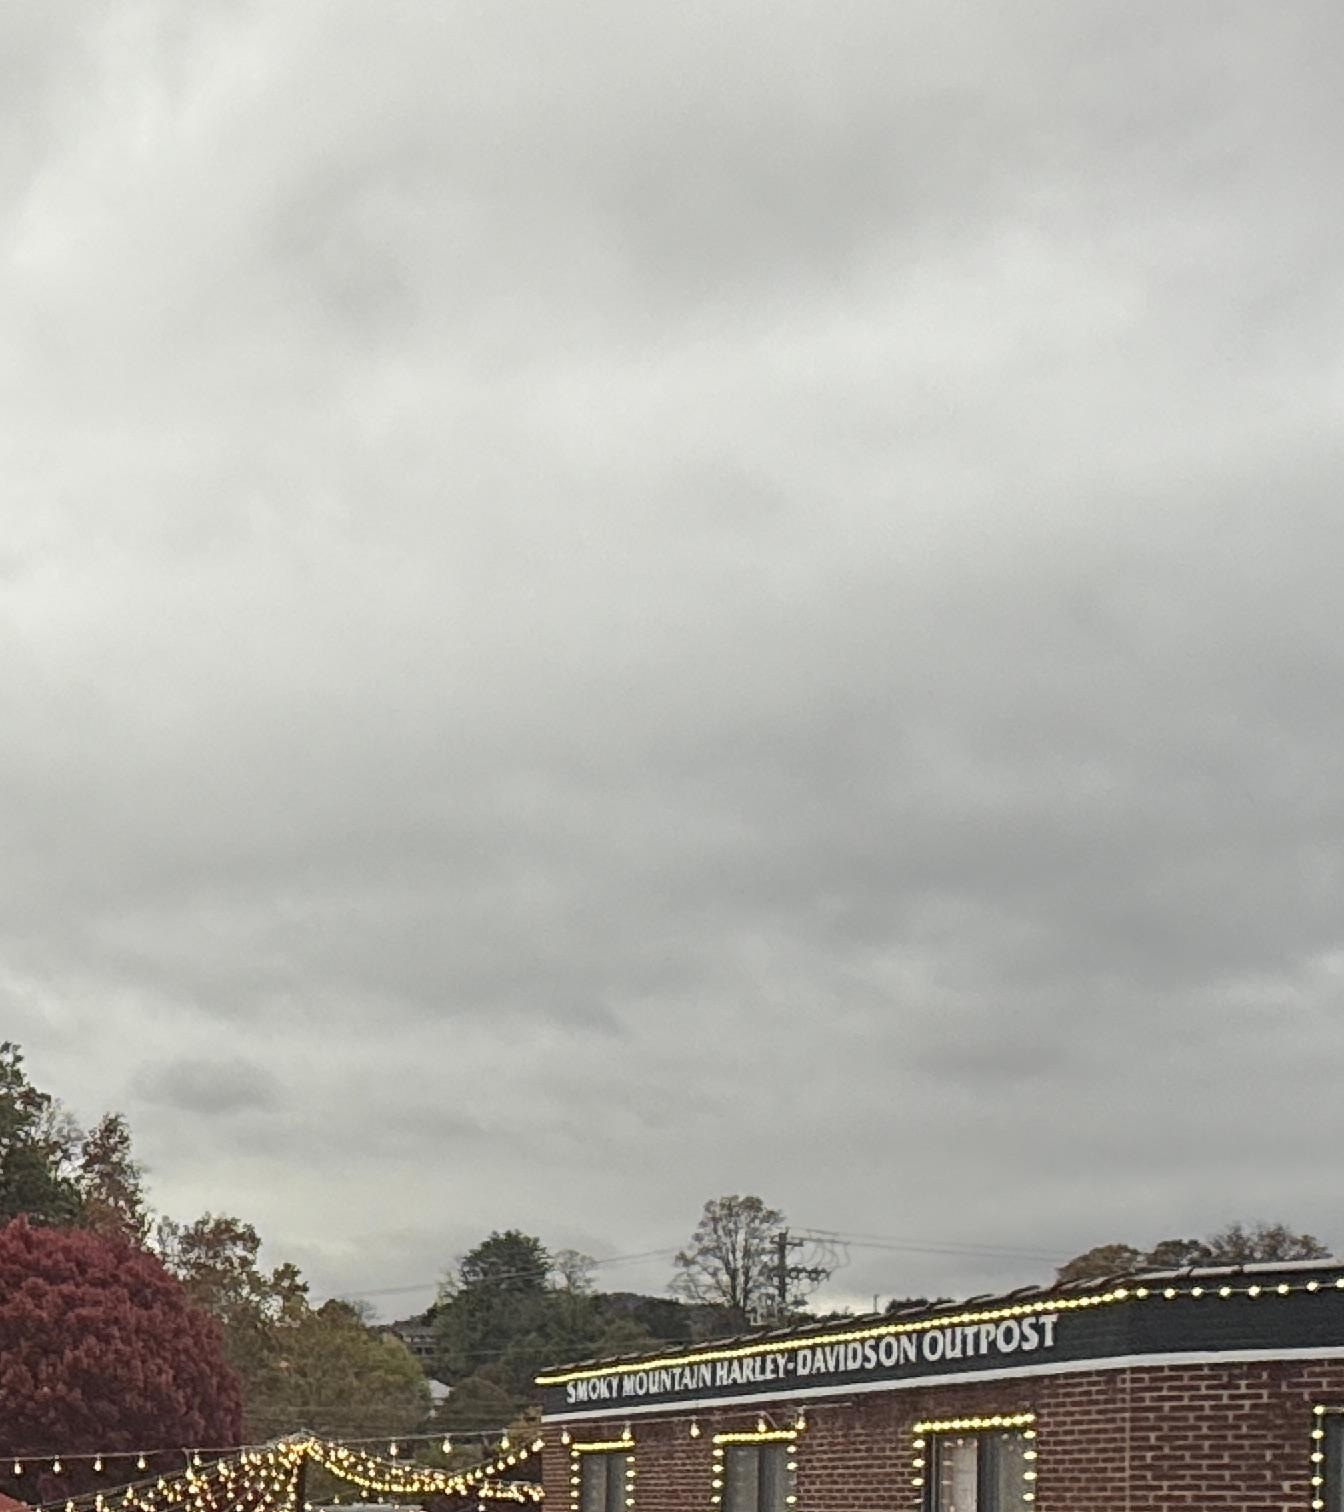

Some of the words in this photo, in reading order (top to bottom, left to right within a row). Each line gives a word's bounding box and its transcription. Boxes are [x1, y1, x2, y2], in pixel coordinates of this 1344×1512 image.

[567, 1376, 619, 1403] SMOKY
[623, 1363, 711, 1396] MOUNTAIN
[715, 1333, 917, 1386] HARLEY-DAVIDSON
[923, 1314, 1058, 1362] OUTPOST
